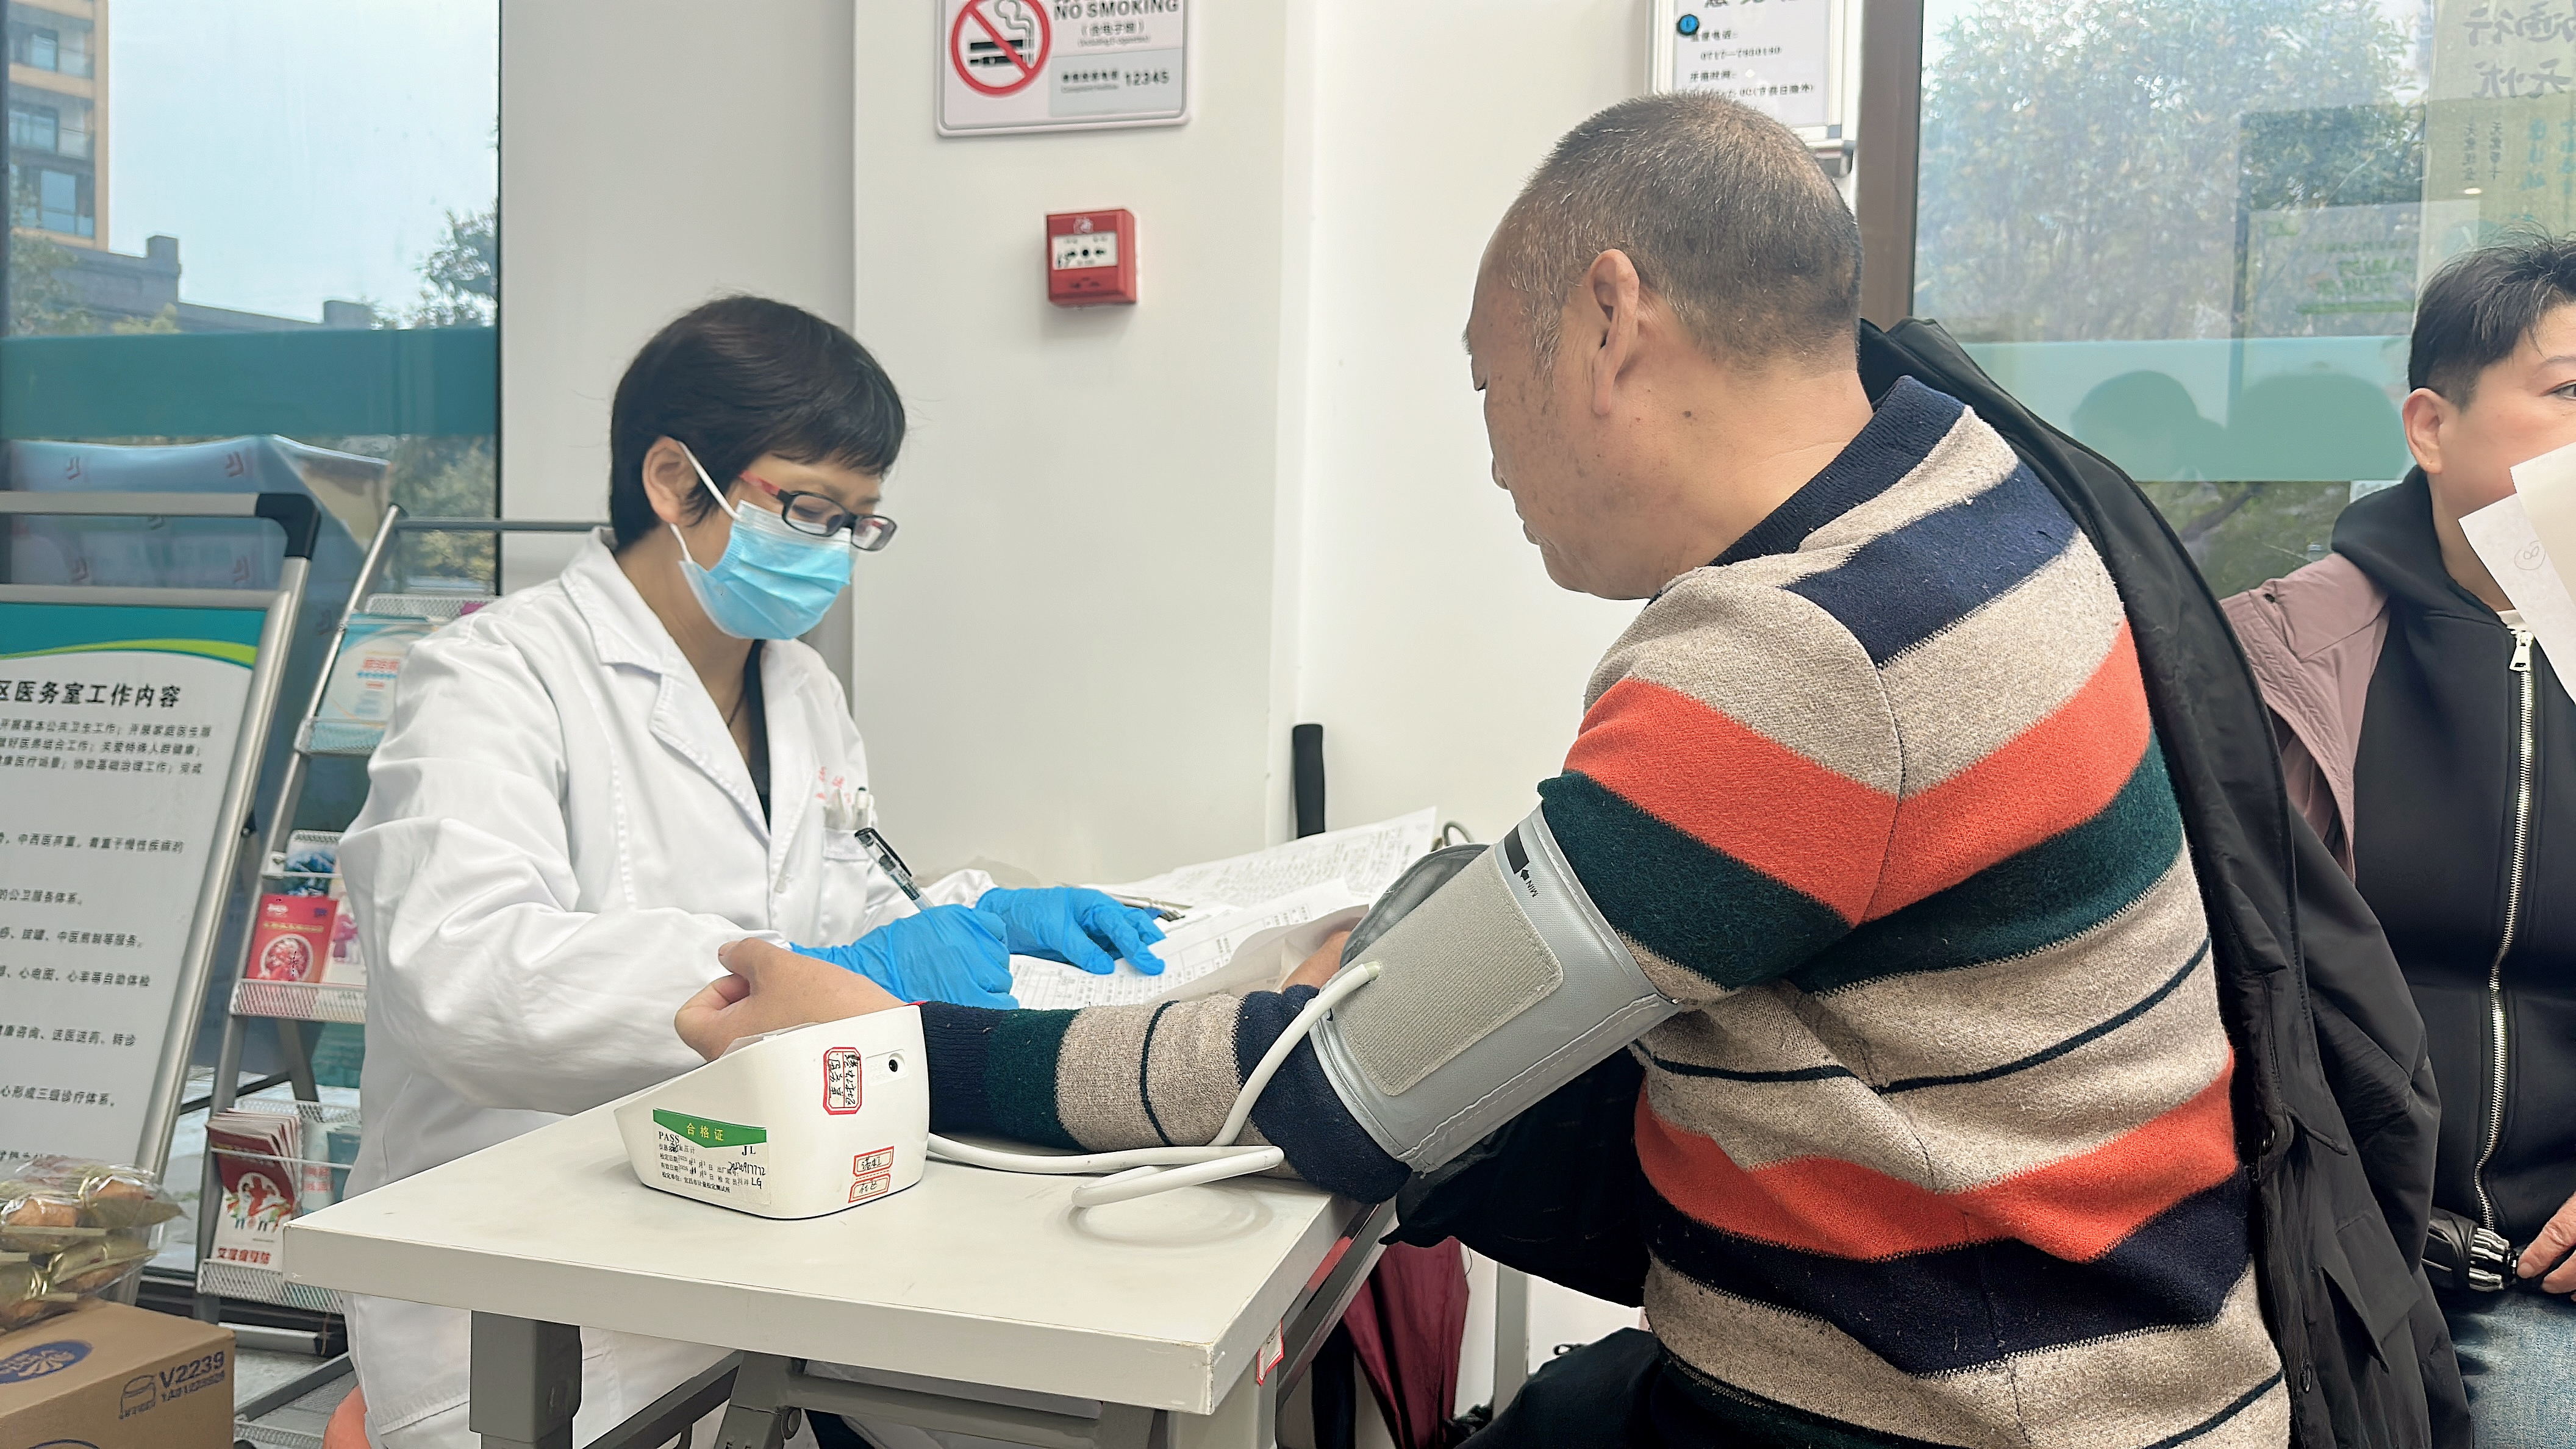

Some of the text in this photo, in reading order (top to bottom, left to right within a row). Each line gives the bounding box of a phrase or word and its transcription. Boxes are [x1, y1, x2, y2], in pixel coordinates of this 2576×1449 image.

[1054, 0, 1179, 20] NO SMOKING
[1126, 70, 1170, 87] 12345
[1526, 879, 1539, 898] MIN
[659, 1131, 680, 1147] PASS
[687, 1122, 724, 1142] 合格证
[159, 1351, 224, 1389] V2239
